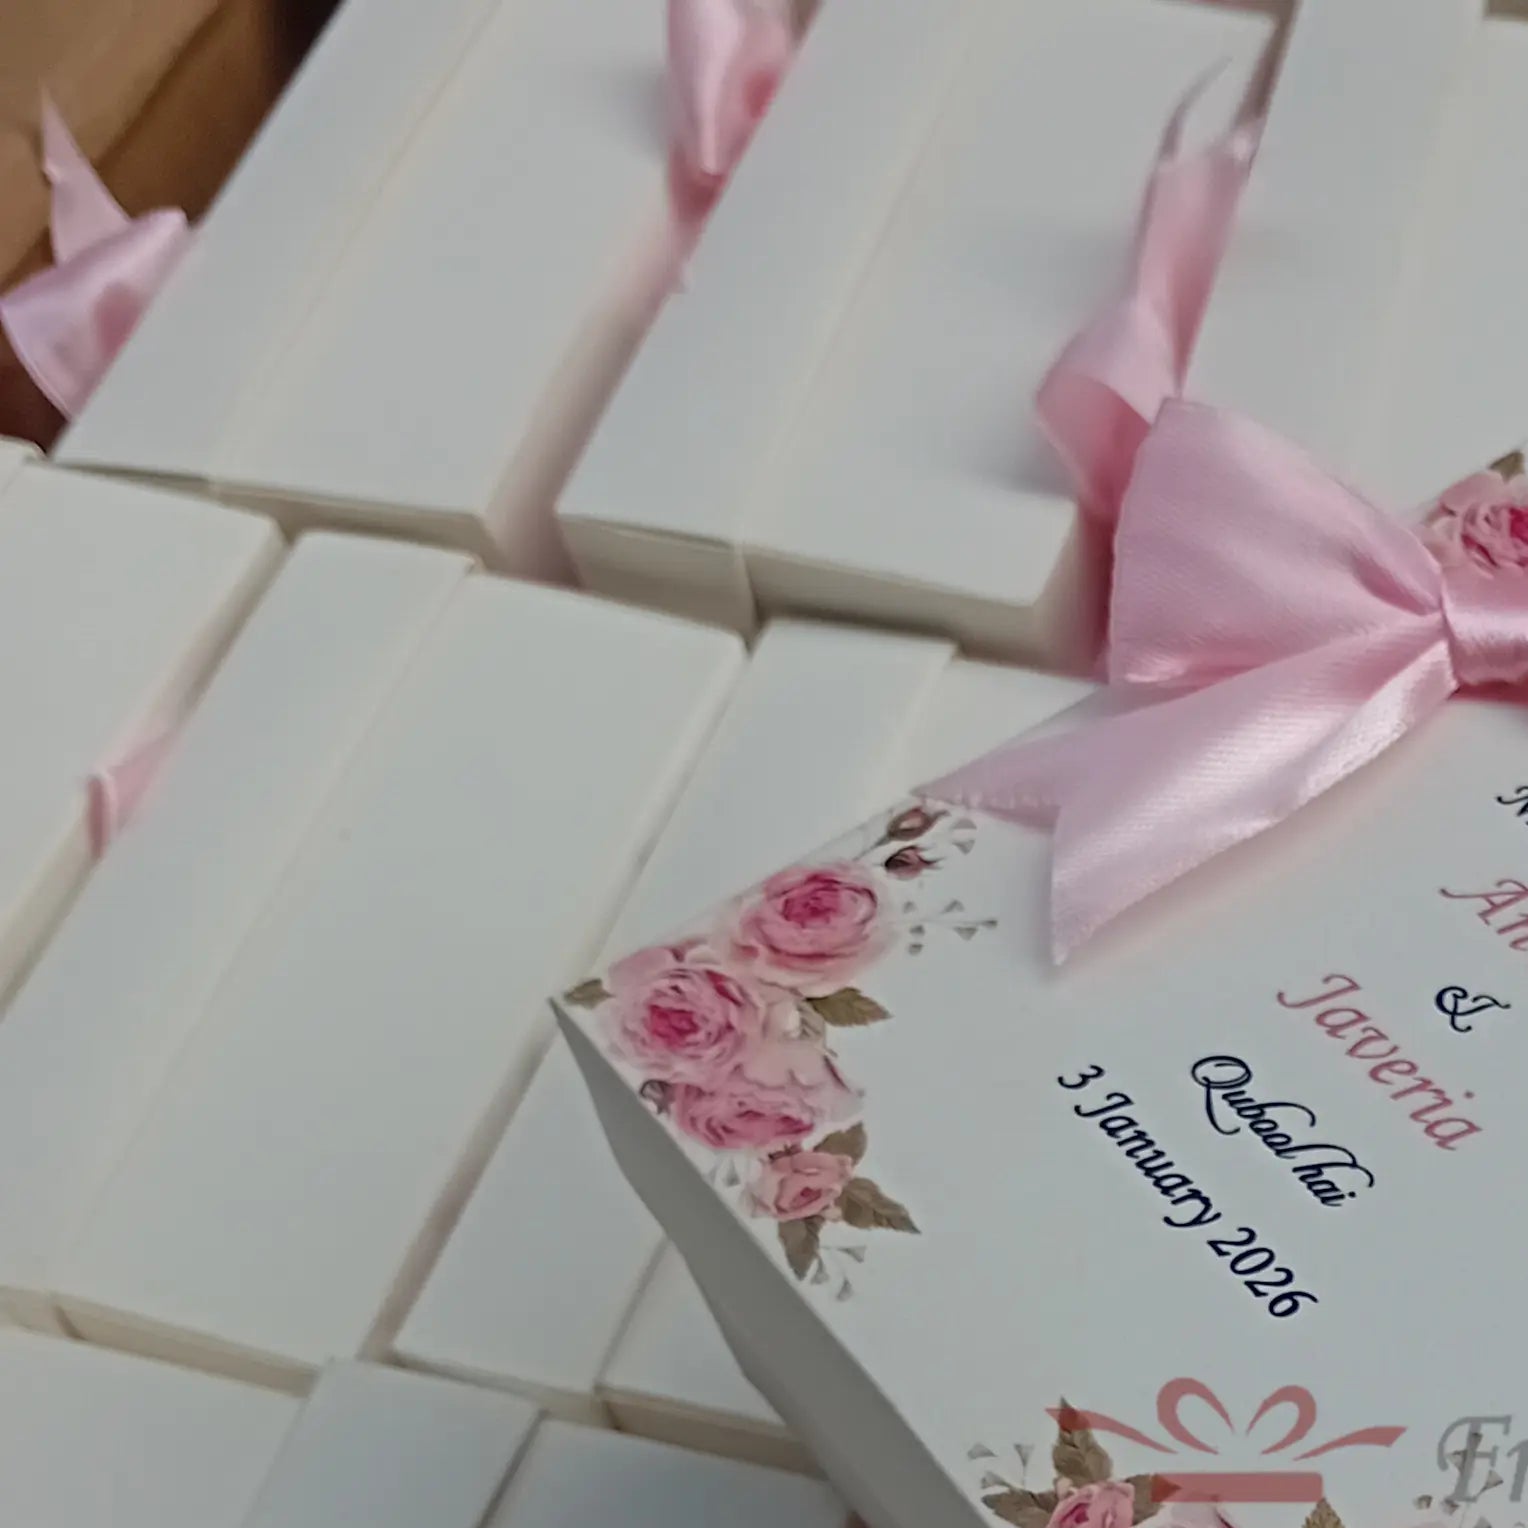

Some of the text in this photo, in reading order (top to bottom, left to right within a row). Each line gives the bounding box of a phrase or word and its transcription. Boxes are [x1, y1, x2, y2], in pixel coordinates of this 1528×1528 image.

[1277, 973, 1483, 1152] Javeria
[1435, 984, 1511, 1034] &
[1057, 1064, 1319, 1319] 3 January 2026
[1190, 1055, 1375, 1207] Qubool hai
